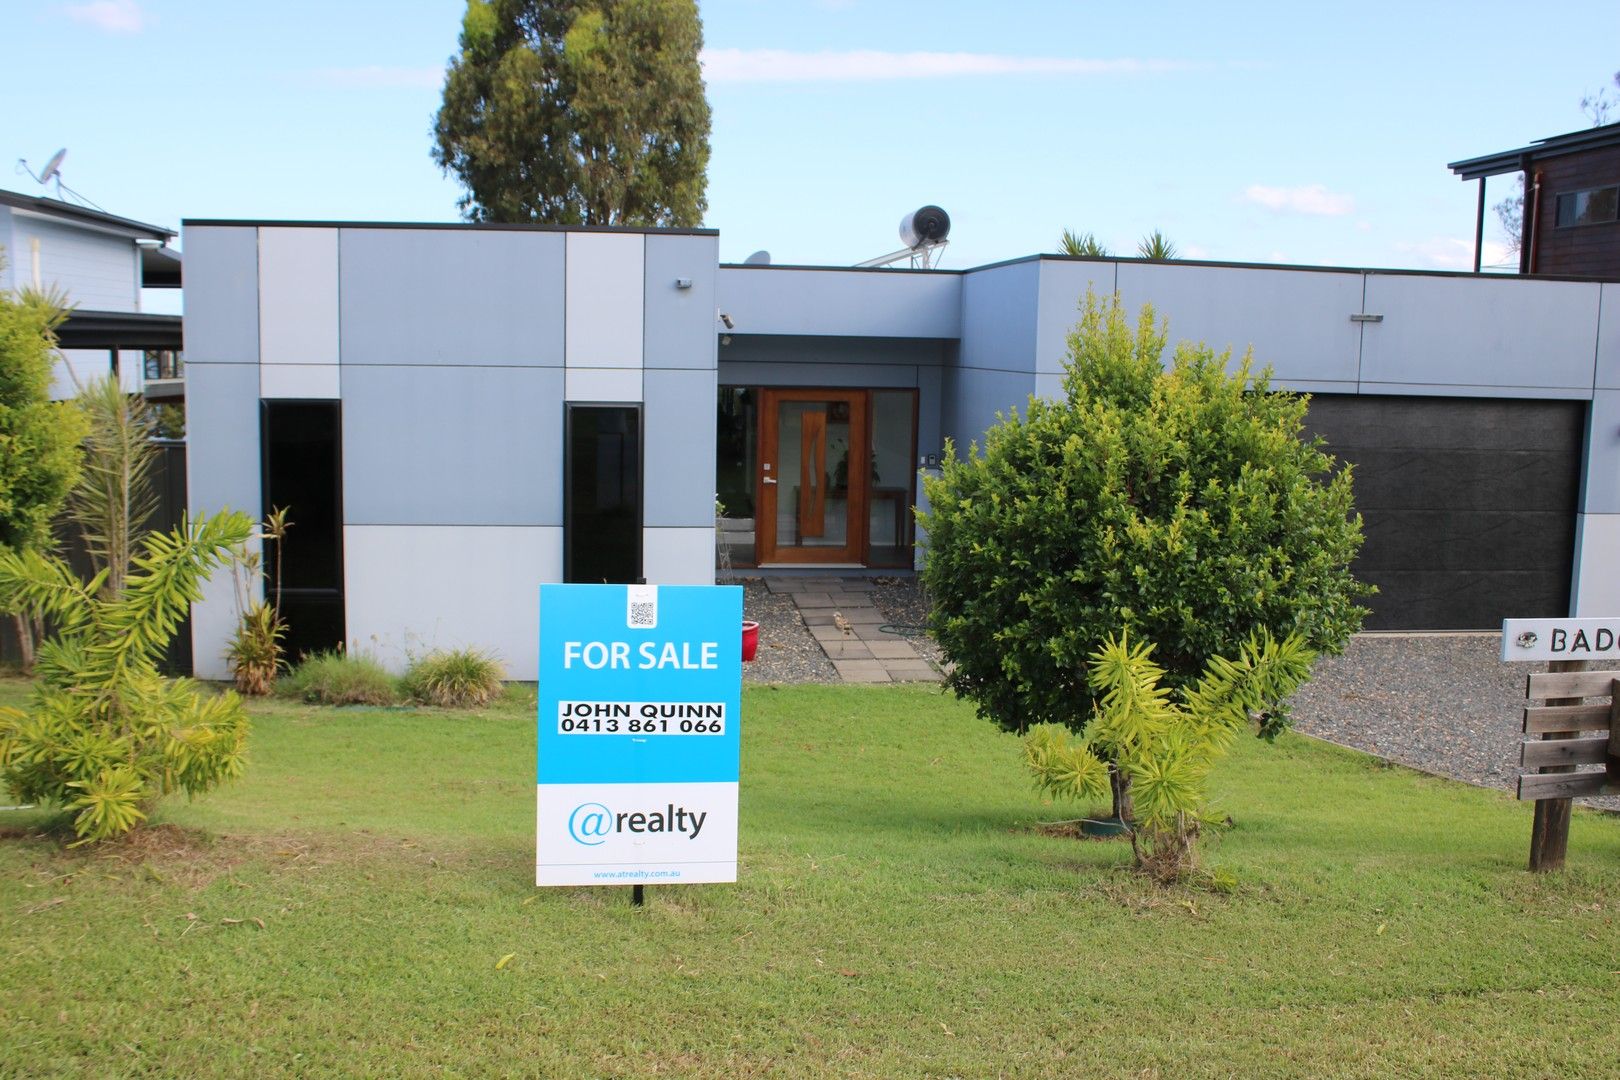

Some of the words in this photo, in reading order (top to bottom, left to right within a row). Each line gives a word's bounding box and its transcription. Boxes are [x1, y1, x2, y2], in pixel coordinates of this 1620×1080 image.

[1551, 628, 1620, 652] BAD
[564, 641, 631, 669] FOR
[639, 641, 718, 669] SALE
[562, 703, 631, 717] JOHN
[640, 704, 722, 719] QUINN
[561, 719, 619, 732] 0413
[628, 719, 668, 733] 861
[680, 720, 722, 733] 066
[568, 802, 707, 846] @realty
[593, 870, 681, 879] www.atrealty.com.au
